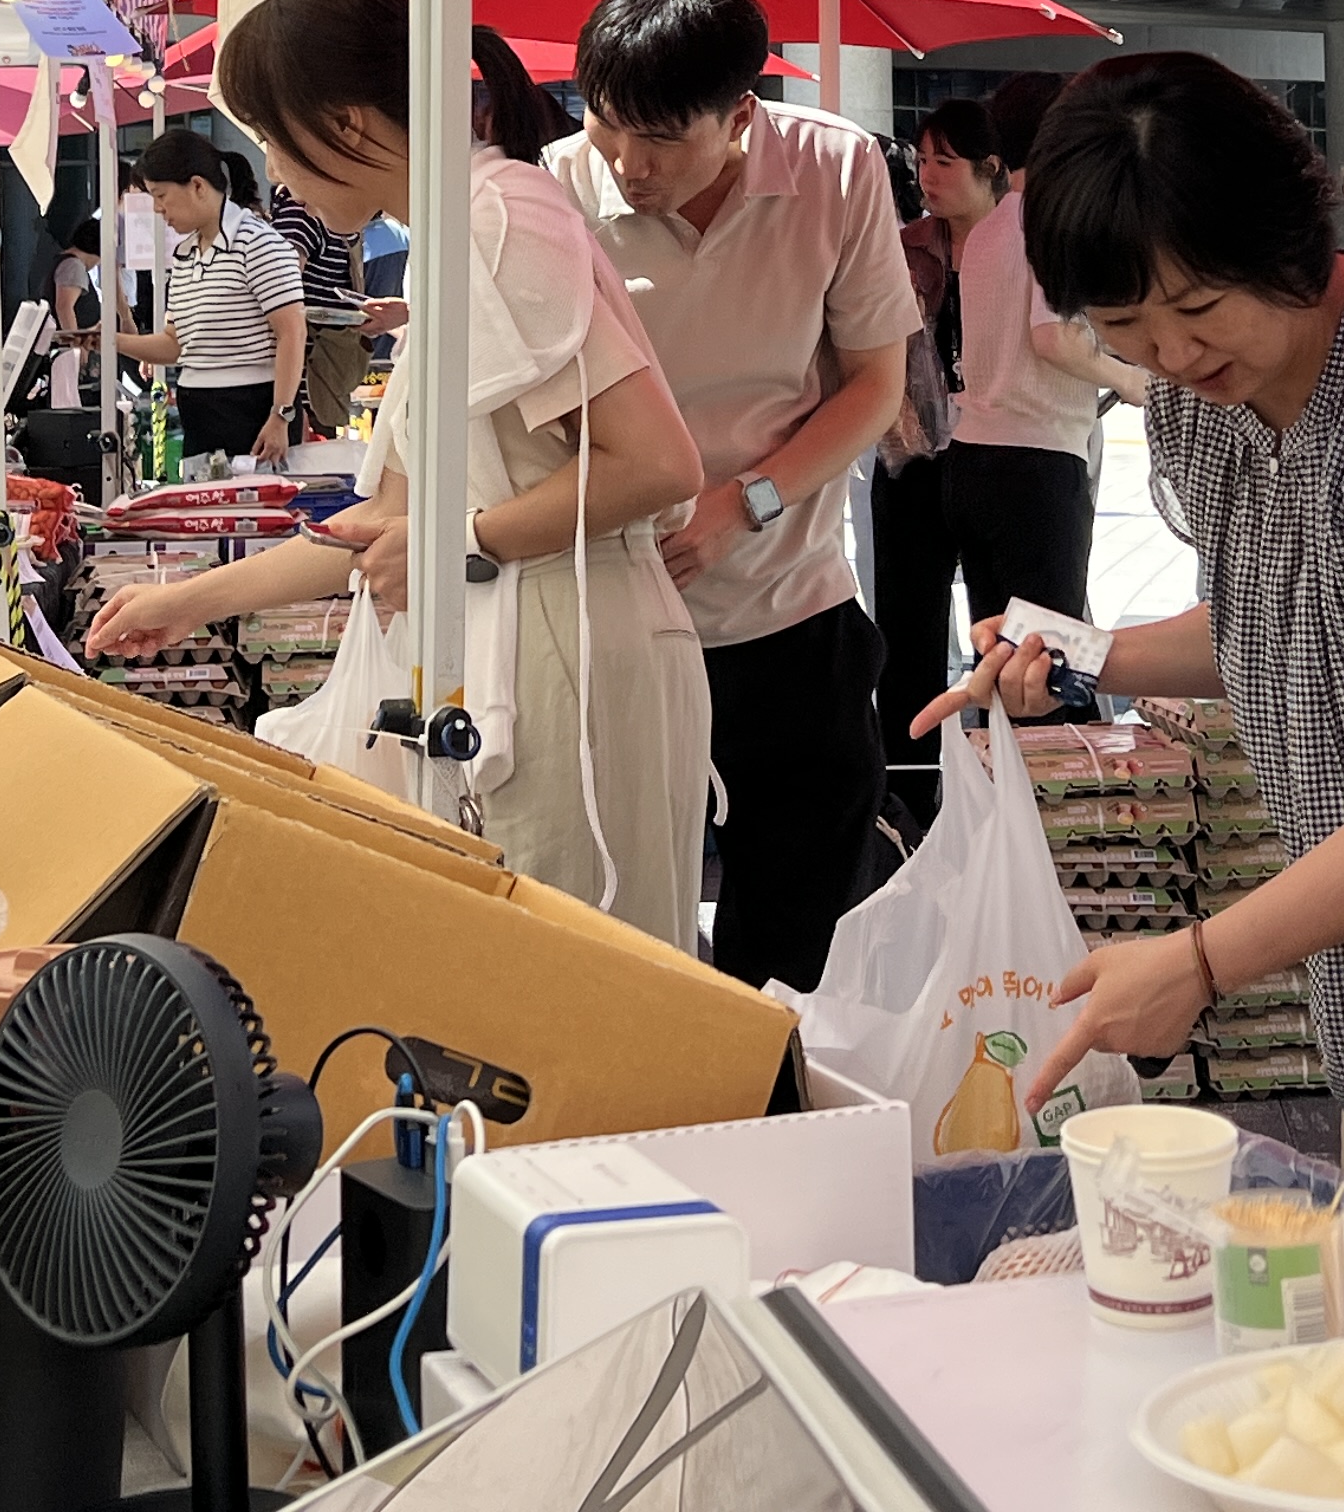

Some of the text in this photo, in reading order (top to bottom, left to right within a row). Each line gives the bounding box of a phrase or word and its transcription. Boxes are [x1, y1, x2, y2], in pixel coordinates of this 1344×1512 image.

[185, 490, 230, 505] 여주쌀
[184, 518, 229, 533] 여주쌀
[1042, 1101, 1073, 1123] GAP
